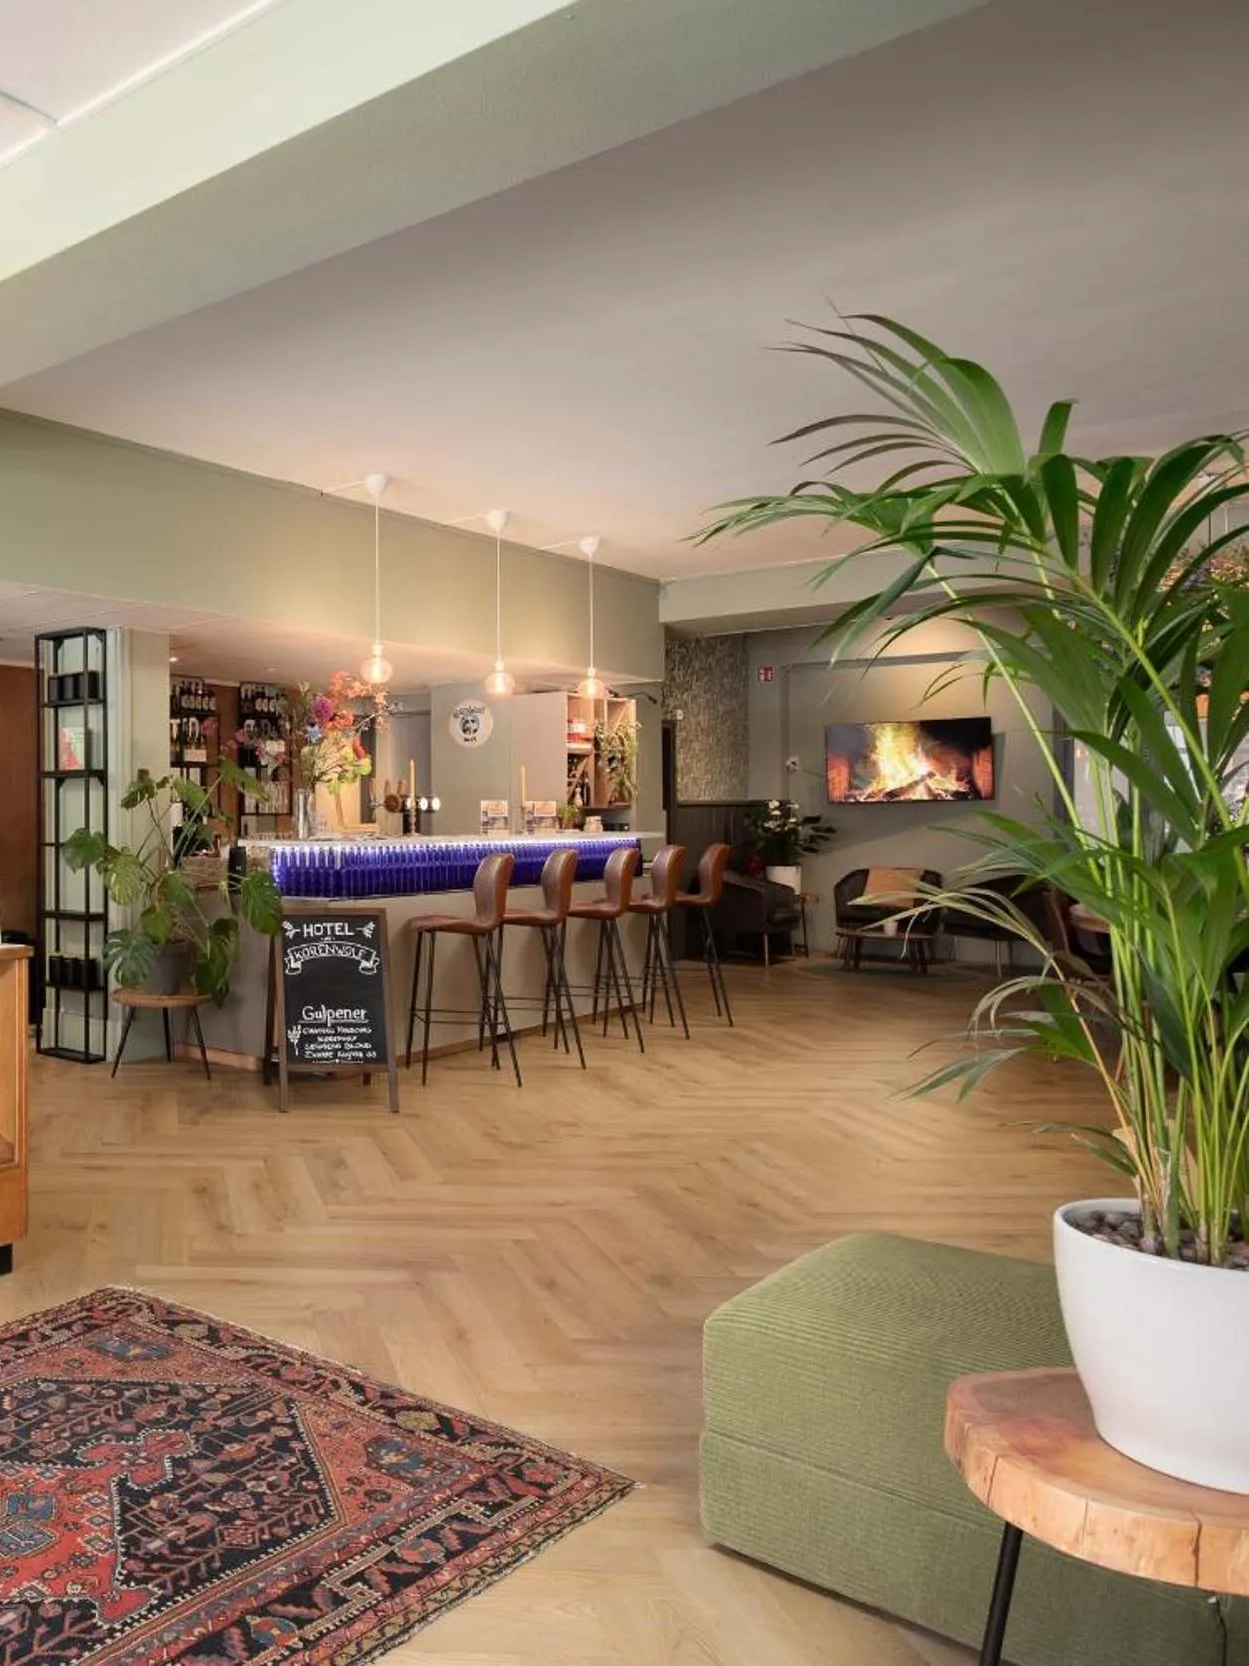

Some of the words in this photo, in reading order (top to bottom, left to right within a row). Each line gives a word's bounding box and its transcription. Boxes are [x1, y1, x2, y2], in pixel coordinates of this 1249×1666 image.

[303, 922, 355, 937] HOTEL
[294, 944, 366, 961] KORENWOLF
[302, 1004, 367, 1027] Gulpener
